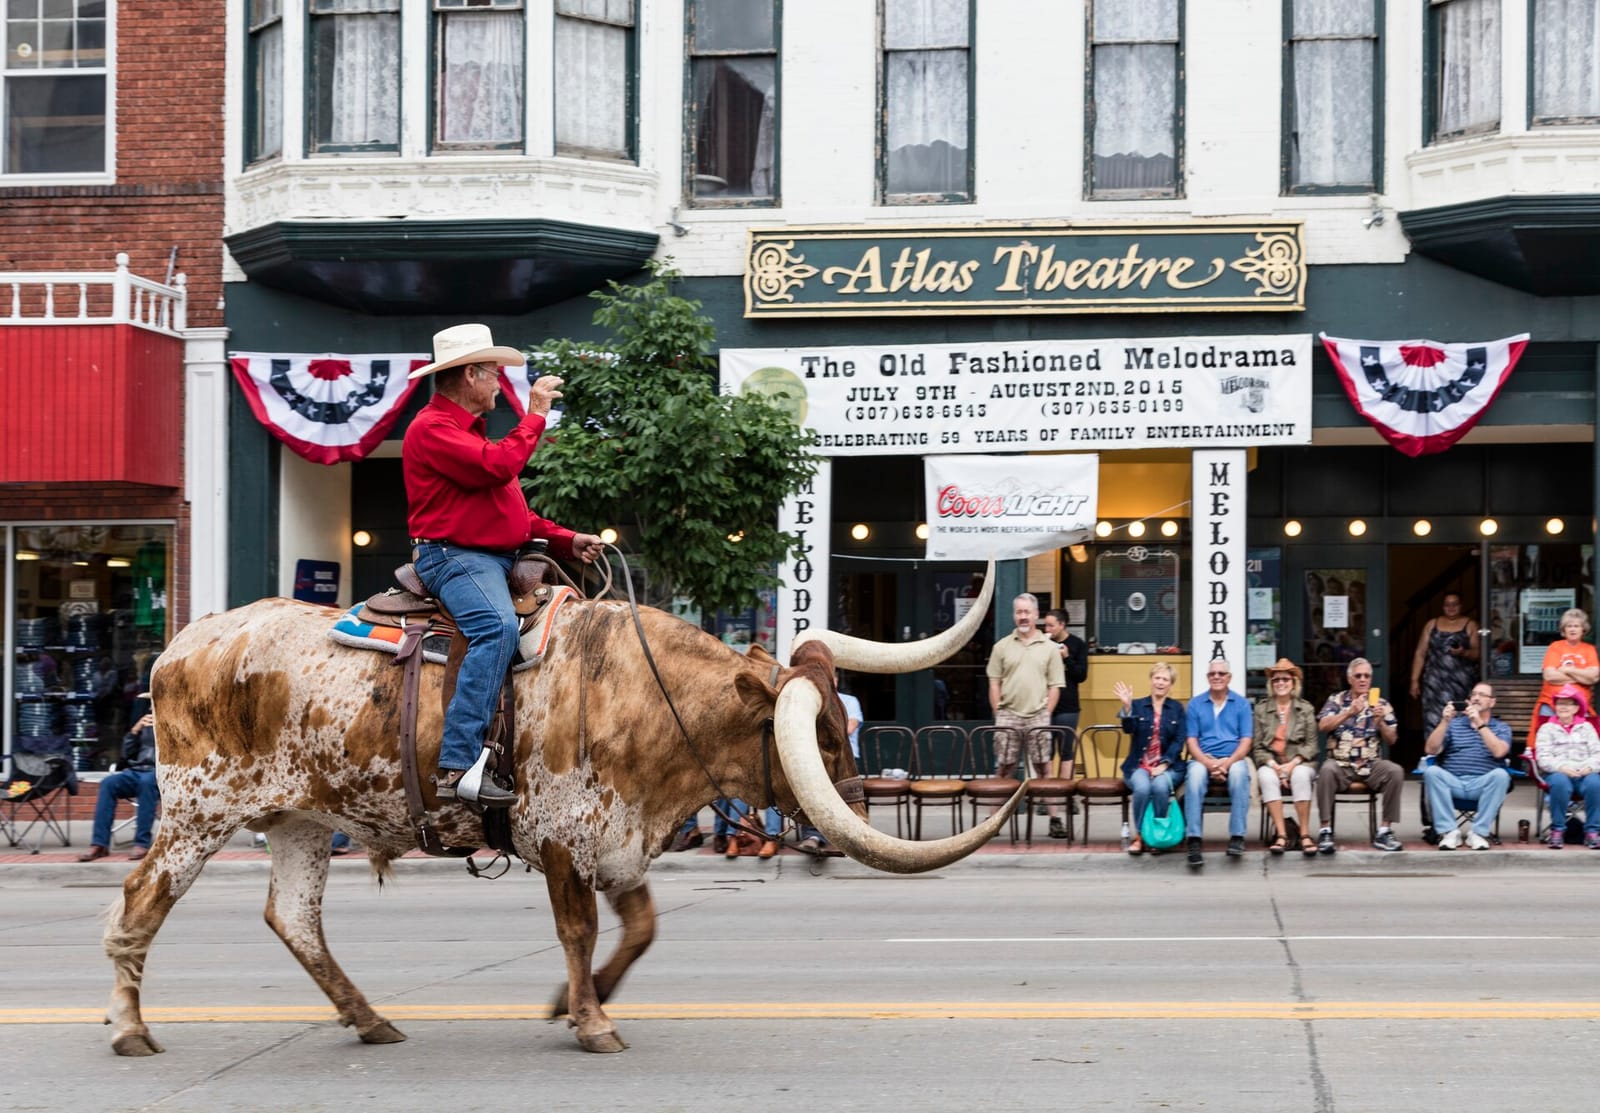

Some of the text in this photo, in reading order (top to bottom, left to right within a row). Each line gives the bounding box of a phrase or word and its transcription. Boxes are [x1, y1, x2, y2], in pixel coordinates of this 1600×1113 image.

[822, 242, 1226, 295] Atlas Theatre
[800, 346, 1297, 378] The Old Fashioned Melodrama
[846, 387, 899, 402] JULY
[916, 385, 957, 400] 9TH
[813, 423, 1296, 447] CELEBRATING 59 YEARS OF FAMILY ENTERTAINMENT
[937, 484, 1089, 518] Coors LIGHT
[936, 525, 946, 533] THE
[950, 525, 978, 533] WORLD'S
[981, 525, 999, 533] MOST
